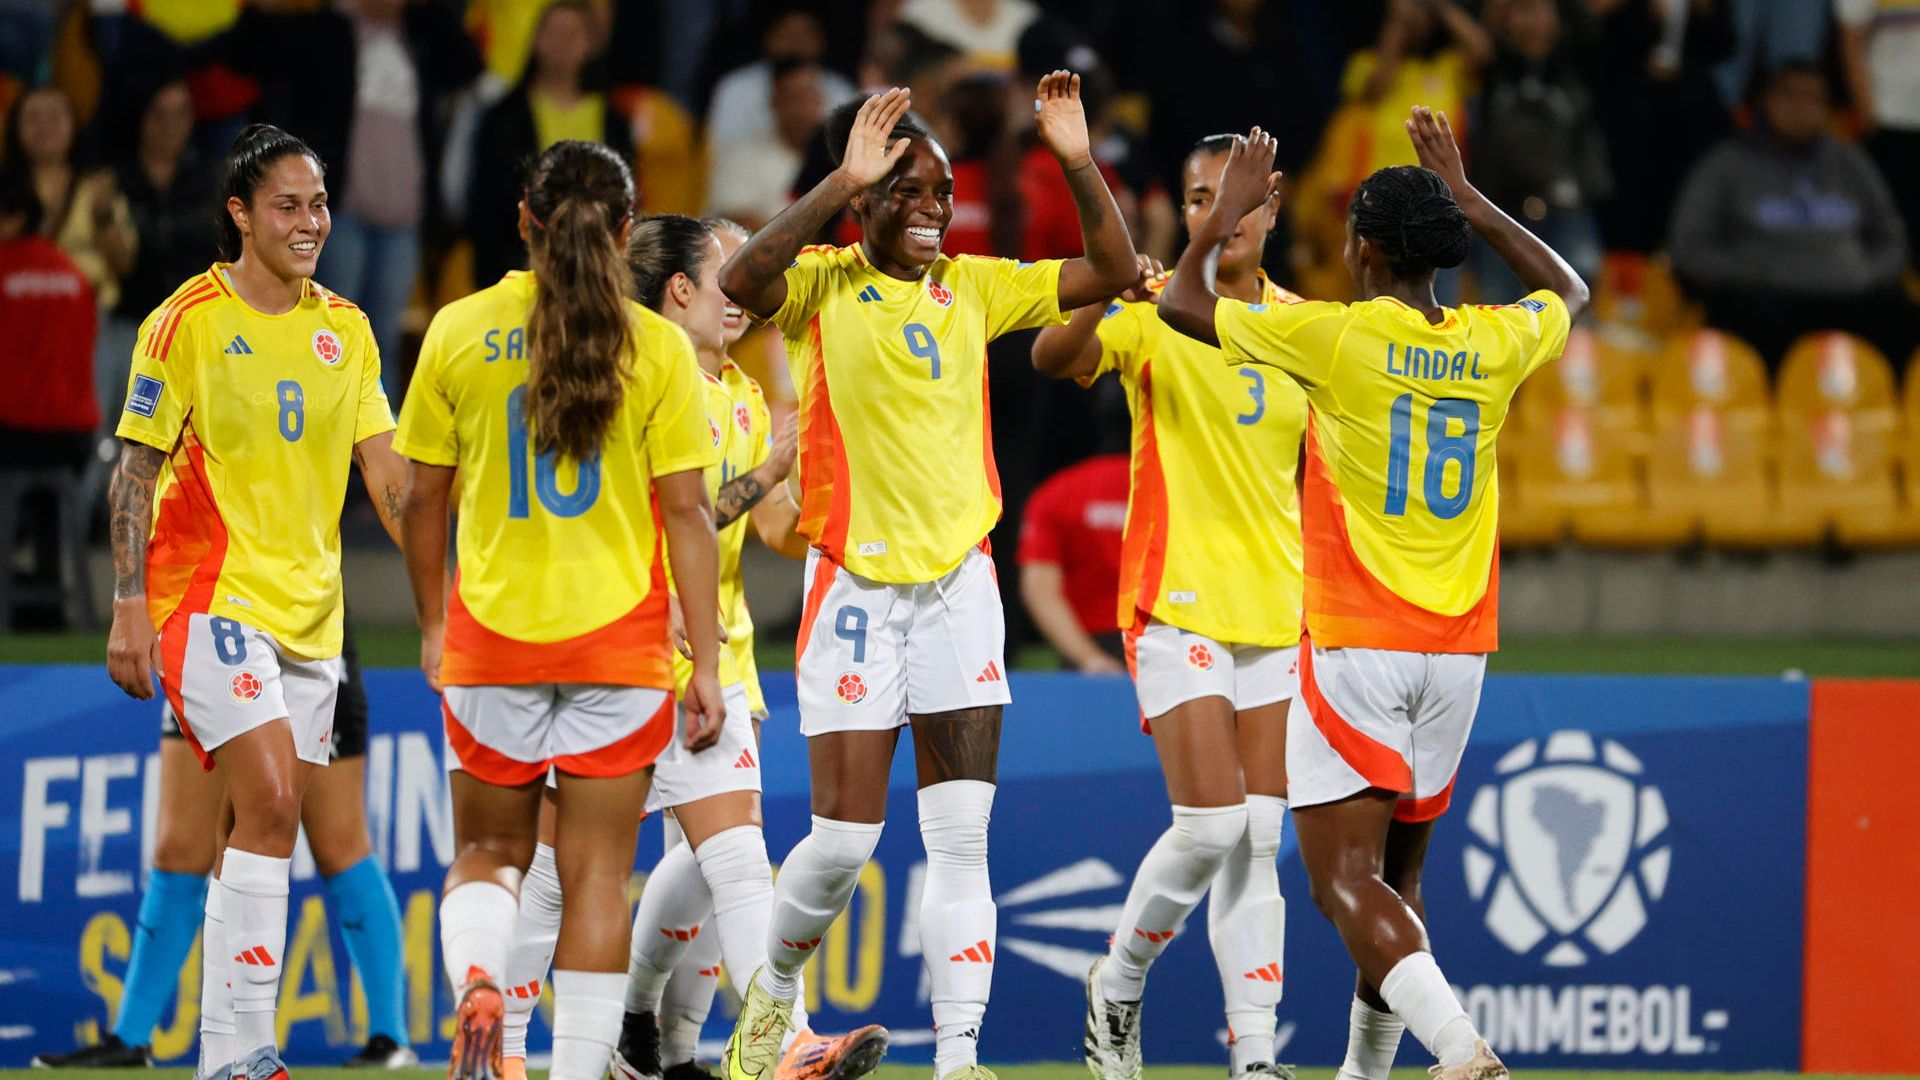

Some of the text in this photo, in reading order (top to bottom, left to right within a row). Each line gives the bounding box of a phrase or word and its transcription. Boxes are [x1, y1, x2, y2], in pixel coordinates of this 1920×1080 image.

[903, 323, 941, 379] 9
[1387, 343, 1467, 381] LINDA
[277, 380, 304, 442] 8
[1237, 367, 1265, 425] 3
[1384, 393, 1480, 520] 18
[210, 616, 247, 666] 8
[835, 605, 868, 663] 9
